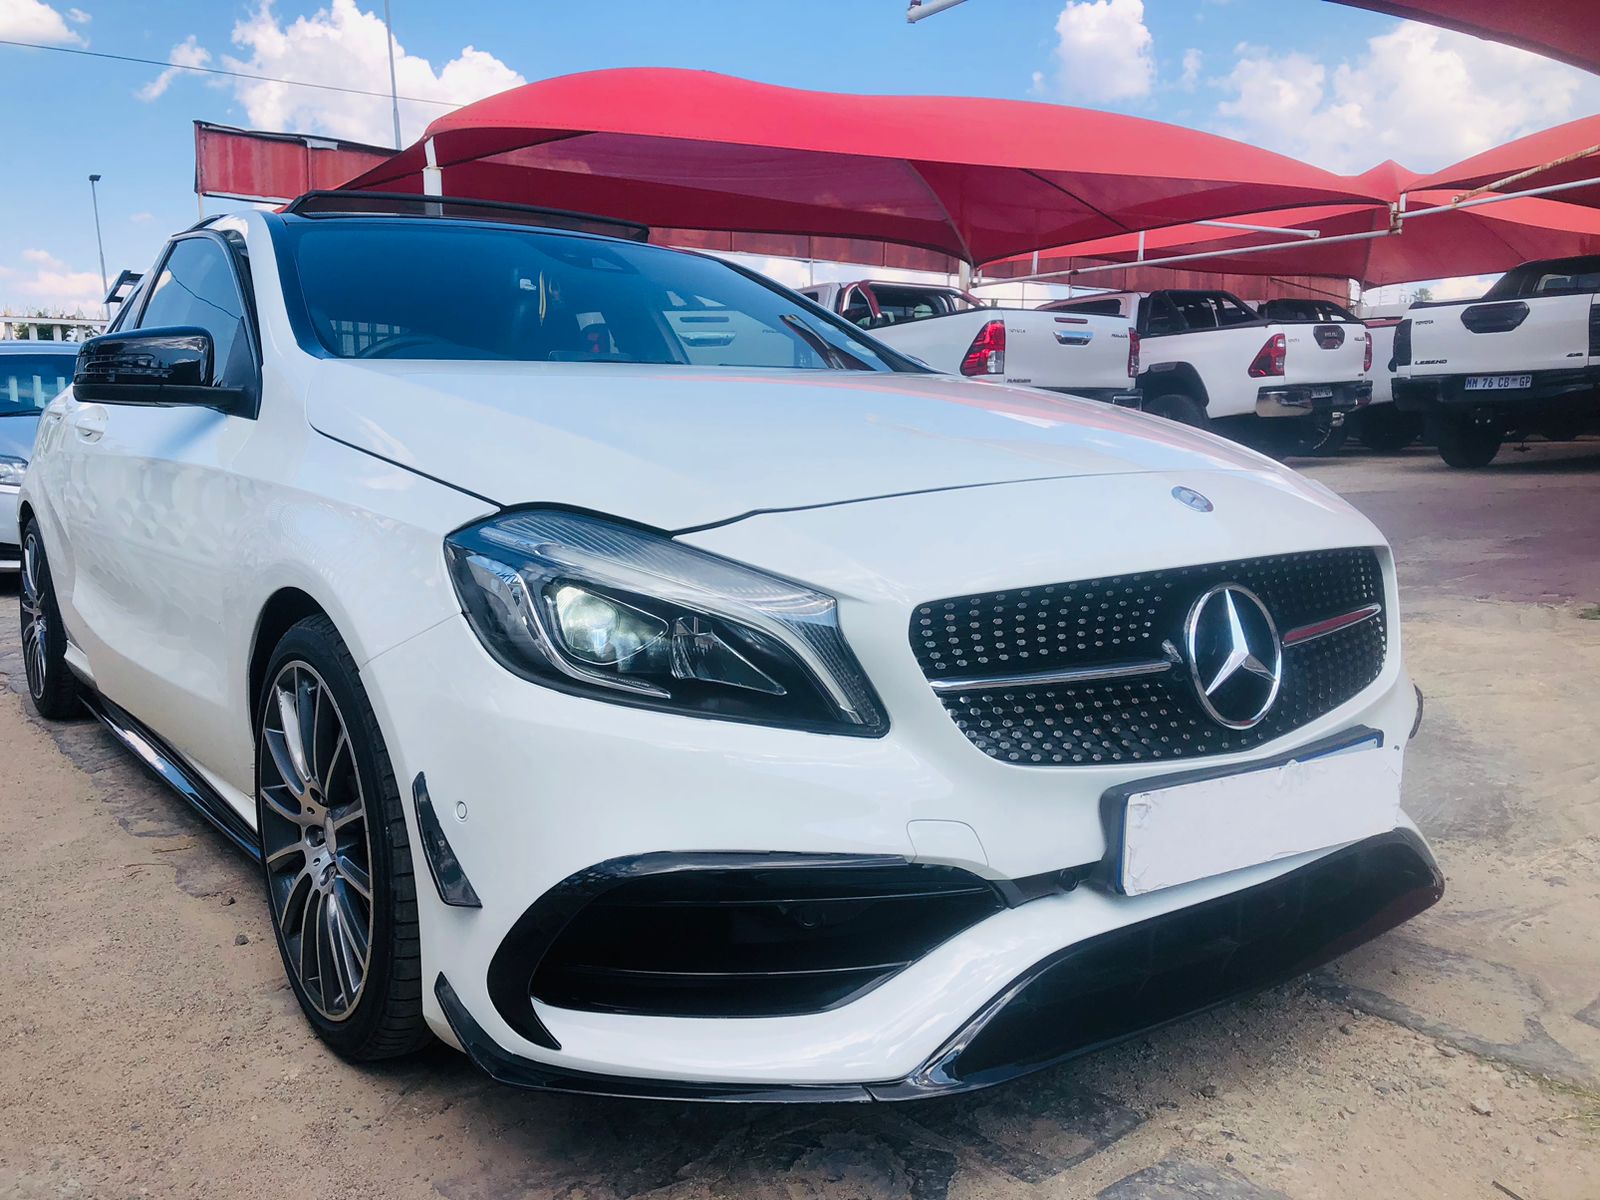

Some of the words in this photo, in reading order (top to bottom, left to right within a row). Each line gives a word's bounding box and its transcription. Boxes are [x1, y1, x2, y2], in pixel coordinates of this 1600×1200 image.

[1482, 377, 1494, 388] 76
[1498, 376, 1510, 388] CB
[1519, 375, 1531, 387] GP
